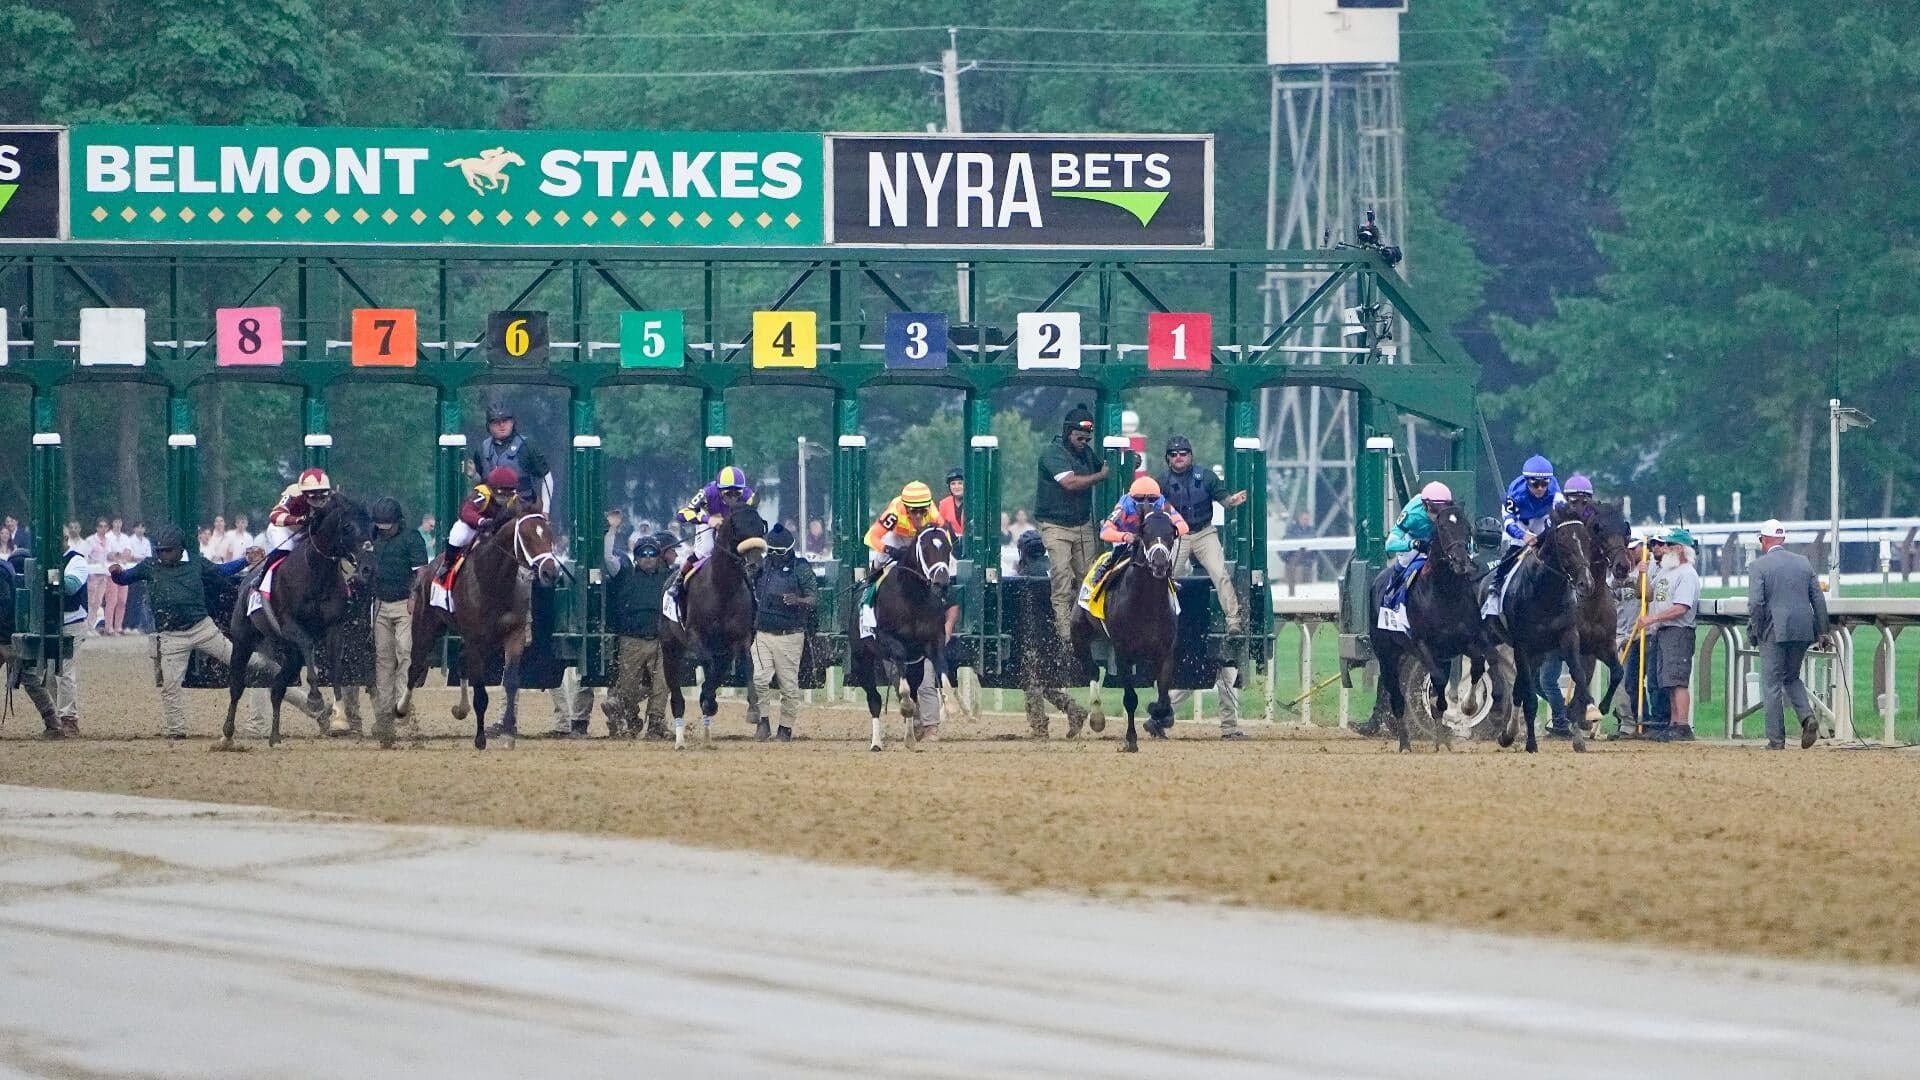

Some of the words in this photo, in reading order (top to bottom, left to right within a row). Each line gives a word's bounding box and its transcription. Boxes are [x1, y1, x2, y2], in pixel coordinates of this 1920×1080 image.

[86, 145, 429, 195] BELMONT
[539, 150, 803, 200] STAKES
[868, 152, 1044, 228] NYRA
[1051, 152, 1172, 189] BETS
[238, 318, 262, 355] 8
[373, 319, 397, 356] 7
[505, 319, 530, 356] 6
[642, 320, 665, 358] 5
[772, 321, 796, 357] 4
[905, 322, 929, 360] 3
[1038, 323, 1061, 359] 2
[1170, 323, 1187, 361] 1
[473, 493, 485, 503] 7
[691, 492, 703, 505] 6
[1506, 499, 1514, 513] 2
[883, 515, 898, 529] 5
